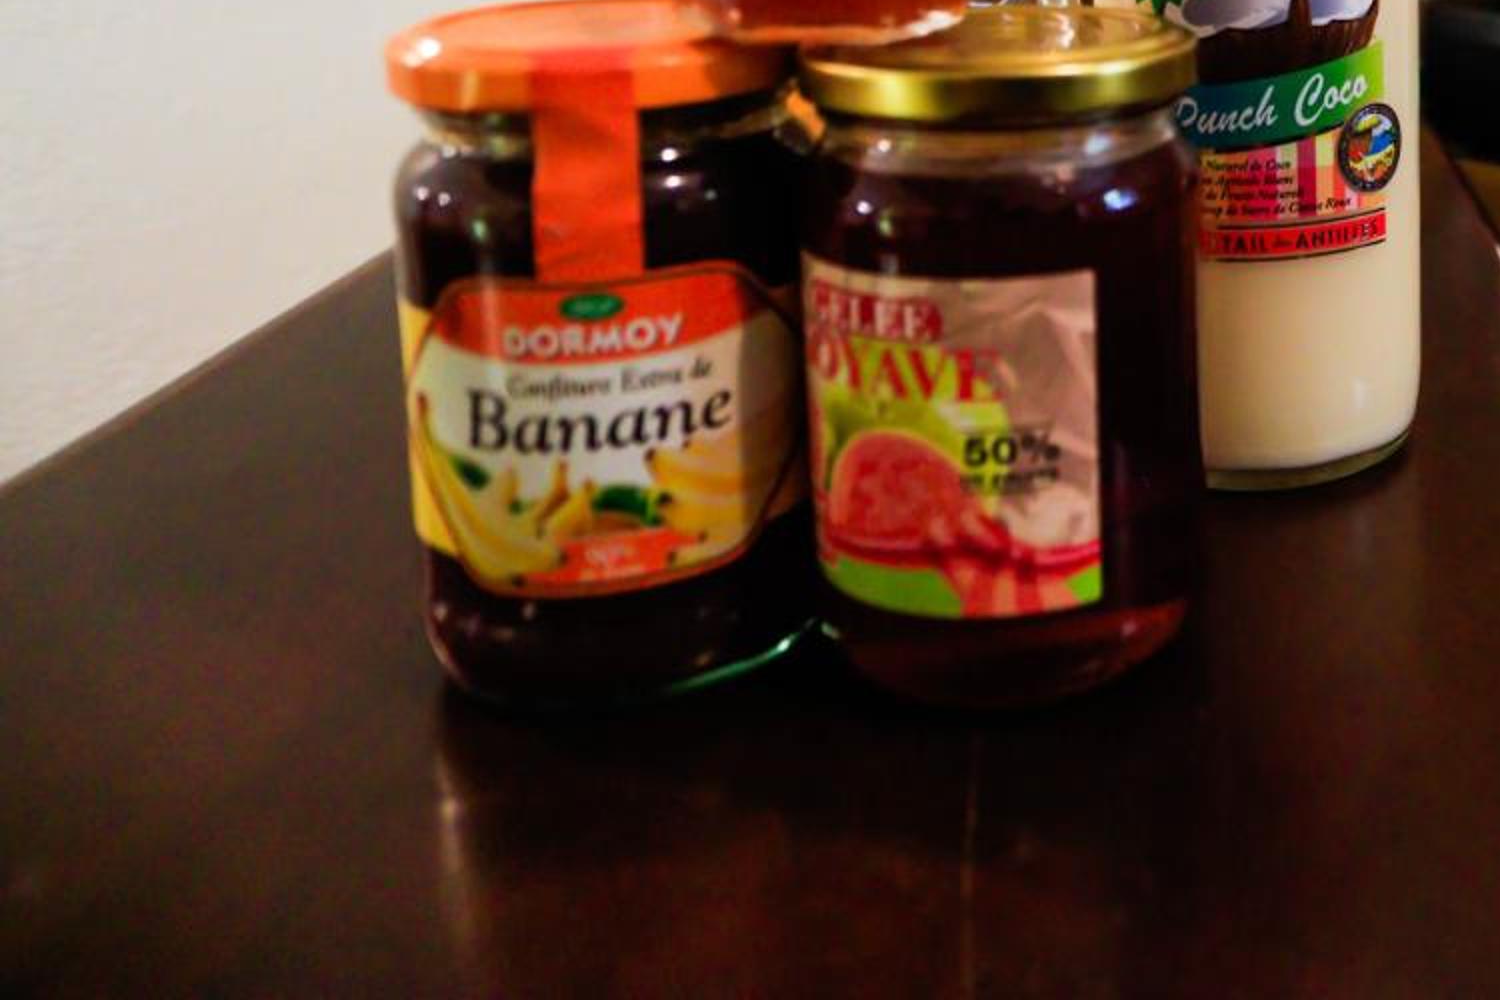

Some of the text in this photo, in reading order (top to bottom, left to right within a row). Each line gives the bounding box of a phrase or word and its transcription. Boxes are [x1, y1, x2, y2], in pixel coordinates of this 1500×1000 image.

[1175, 73, 1367, 133] Punch Coco
[502, 311, 683, 357] DORMOY
[506, 356, 713, 400] Confiture Extra de
[806, 332, 1003, 402] OYAVE
[467, 387, 733, 457] Banane
[963, 429, 1061, 468] 50%
